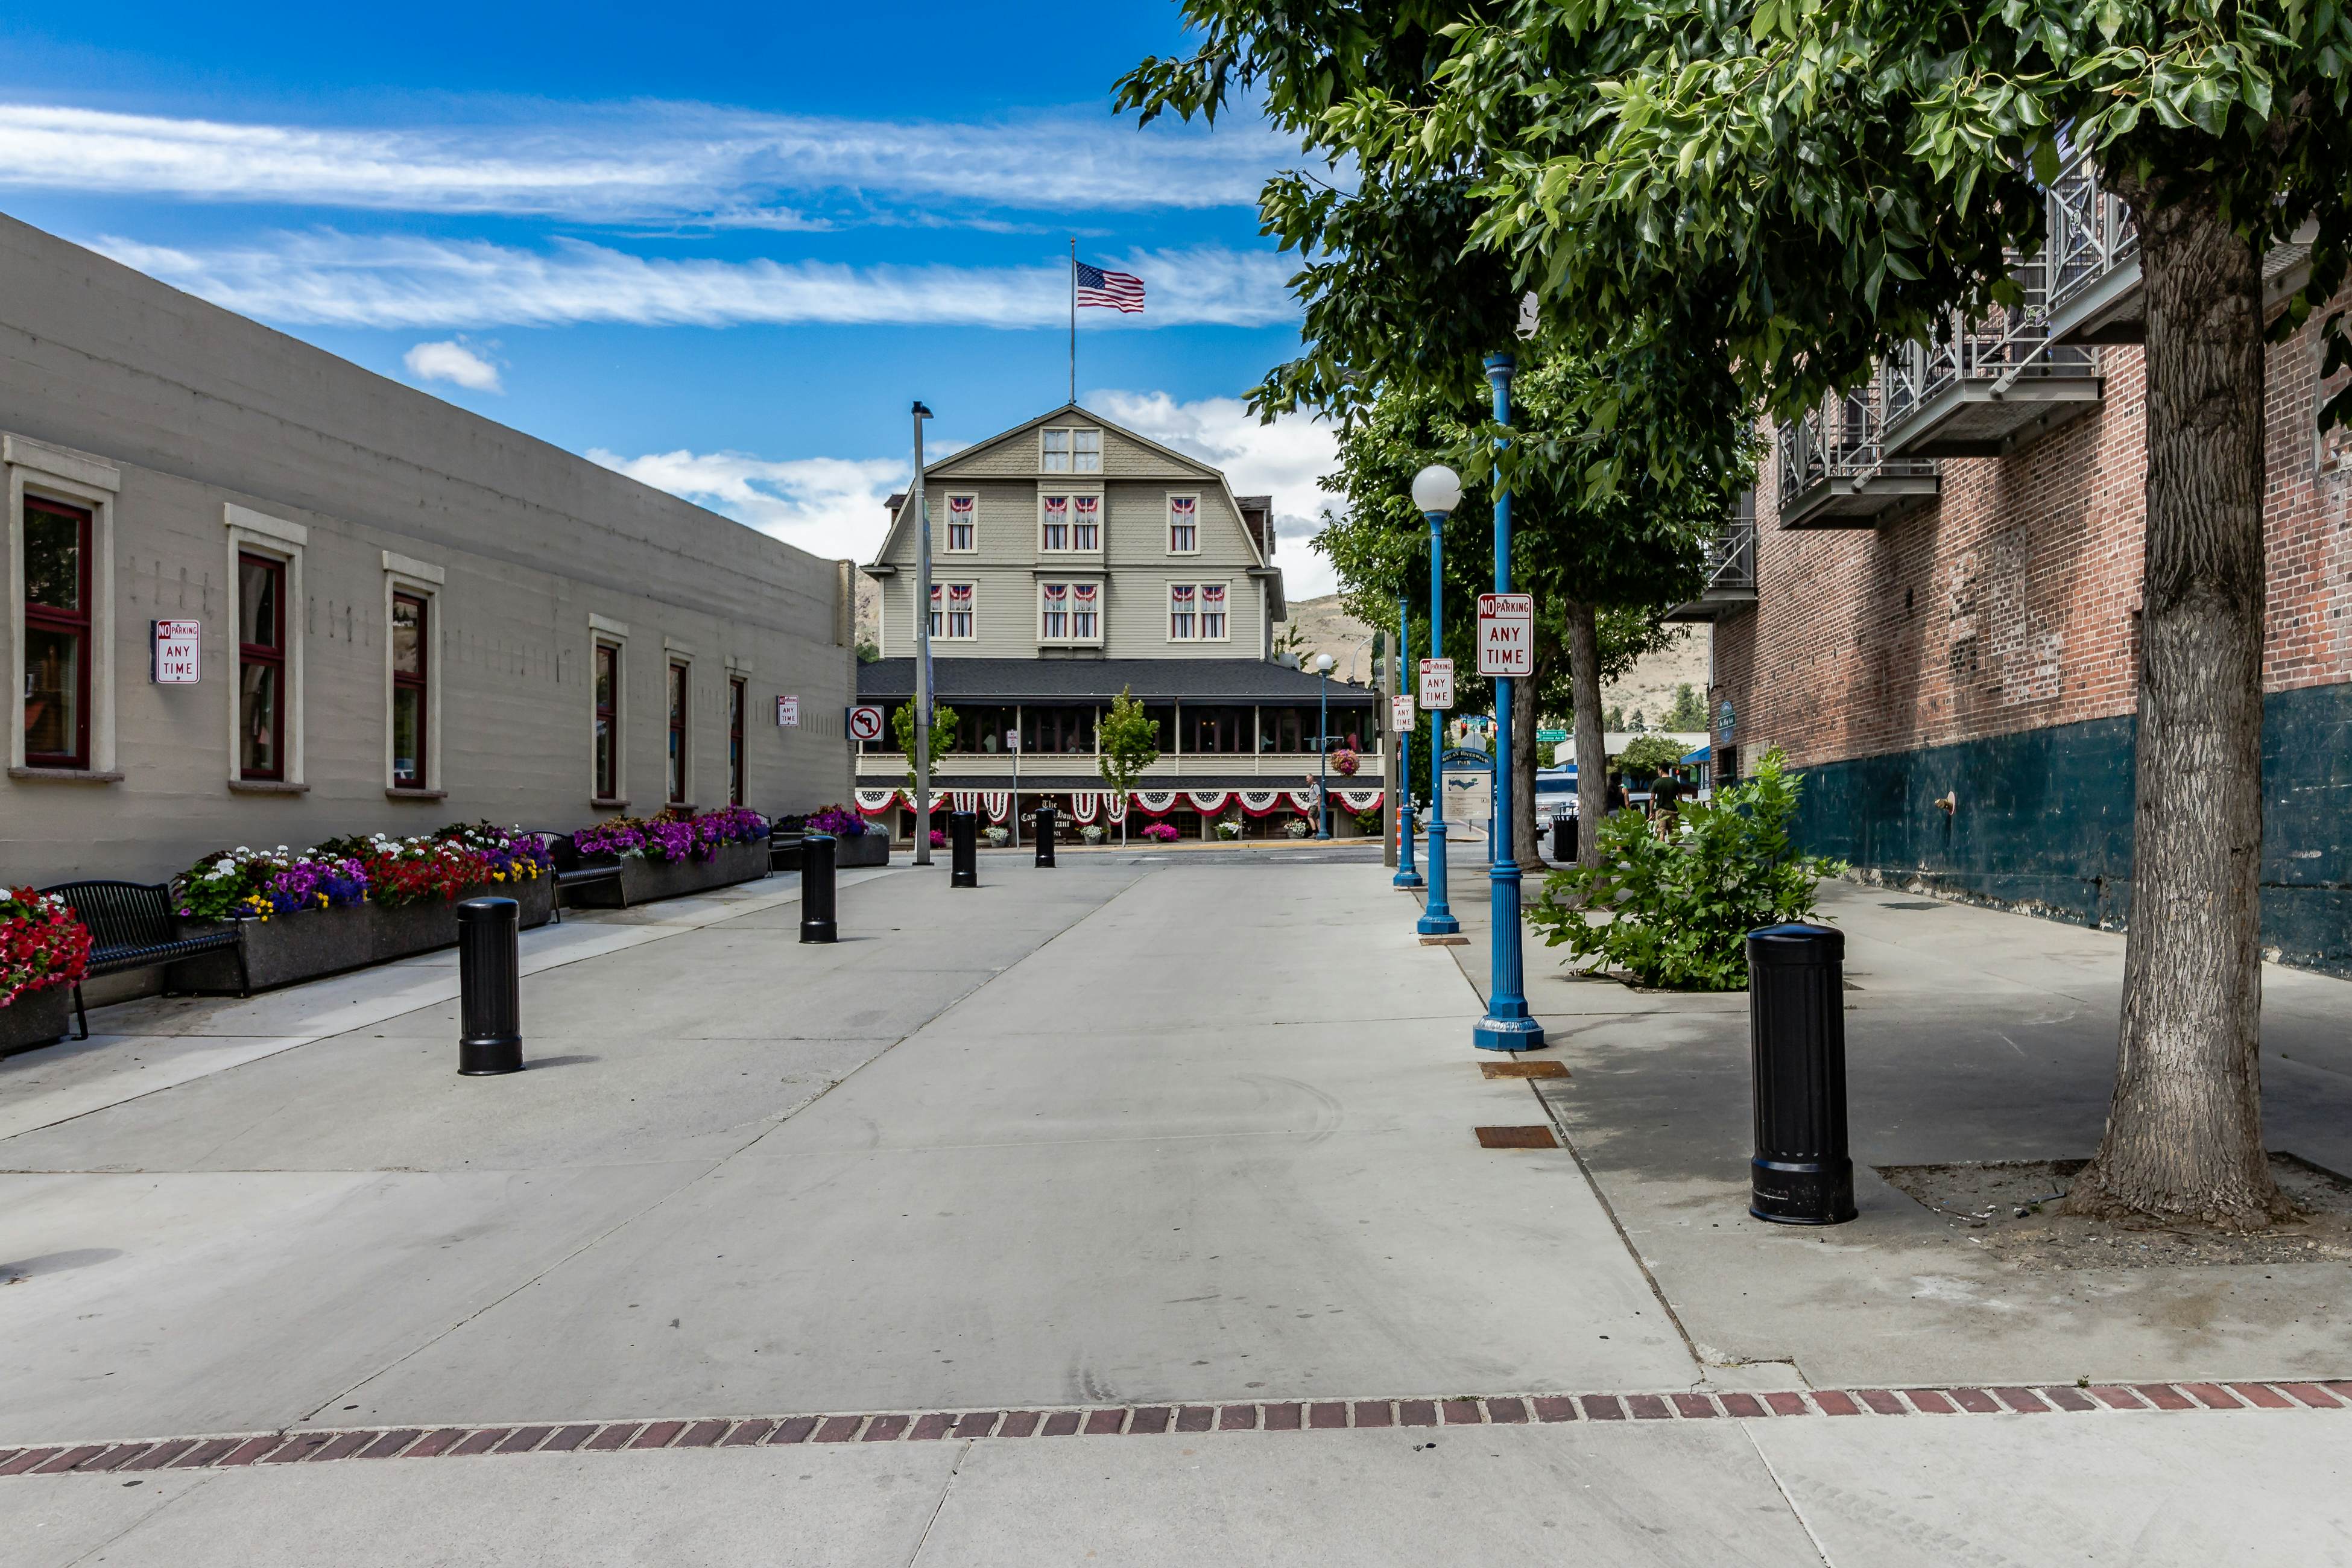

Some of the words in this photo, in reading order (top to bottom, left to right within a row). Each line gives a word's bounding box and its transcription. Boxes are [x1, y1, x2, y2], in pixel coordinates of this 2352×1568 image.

[1481, 599, 1495, 615] NO
[1496, 602, 1529, 613] PARKING
[159, 624, 170, 637] NO
[171, 627, 197, 635] PARKING
[1490, 627, 1520, 642] ANY
[166, 646, 190, 657] ANY
[1487, 650, 1523, 664] TIME
[163, 663, 193, 674] TIME
[1421, 662, 1430, 672] NO
[1427, 678, 1446, 688] ANY
[1425, 692, 1447, 701] TIME
[1442, 751, 1459, 762] HELAN
[1042, 800, 1058, 809] The
